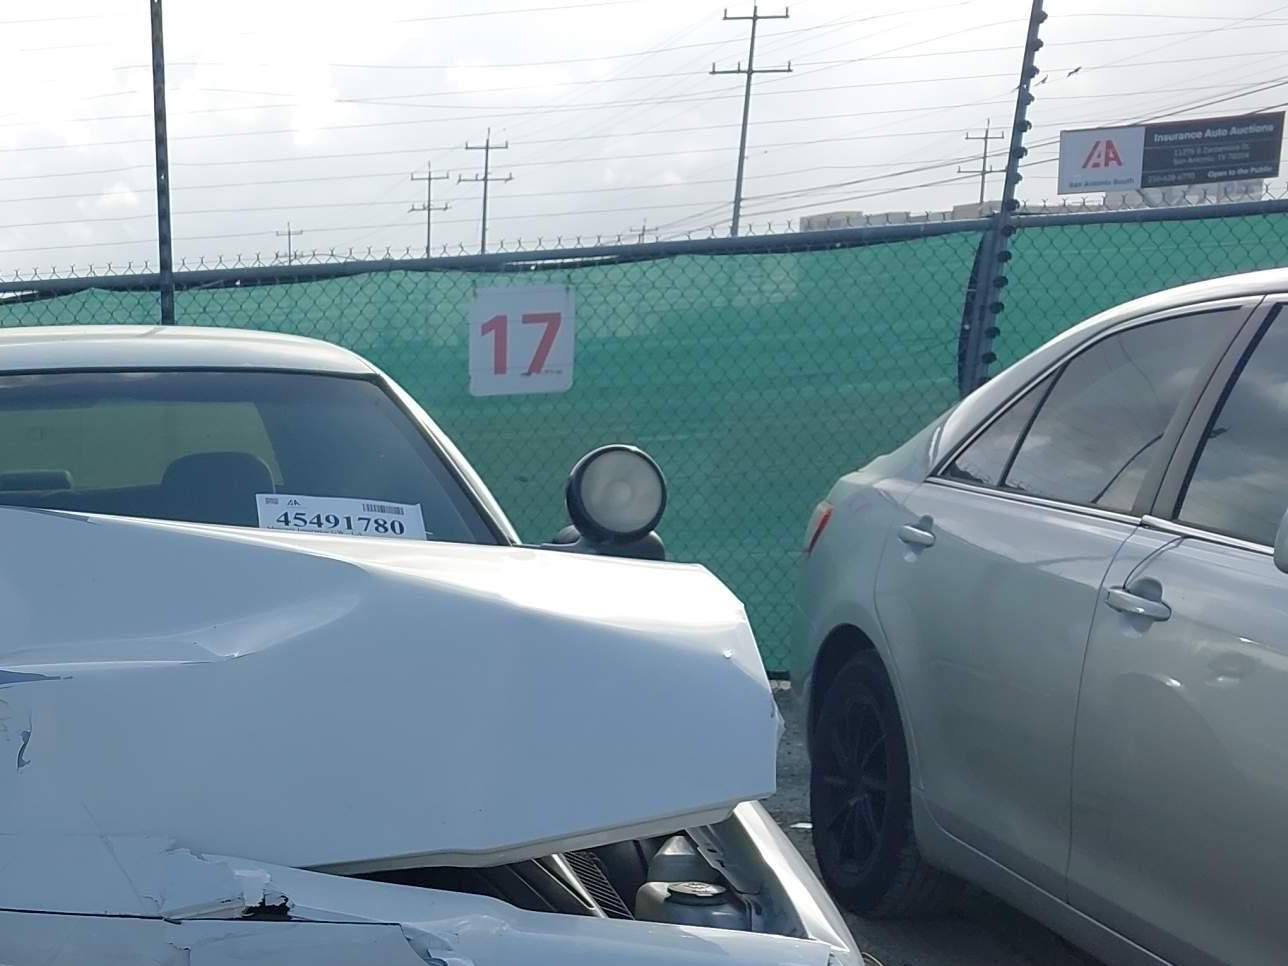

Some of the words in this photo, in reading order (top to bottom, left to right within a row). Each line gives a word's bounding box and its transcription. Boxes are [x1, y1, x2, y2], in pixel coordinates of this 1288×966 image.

[1154, 131, 1203, 142] Insurance
[1204, 129, 1227, 138] Auto
[1230, 124, 1274, 135] Auctions
[481, 312, 562, 375] 17
[275, 511, 405, 536] 45491780
